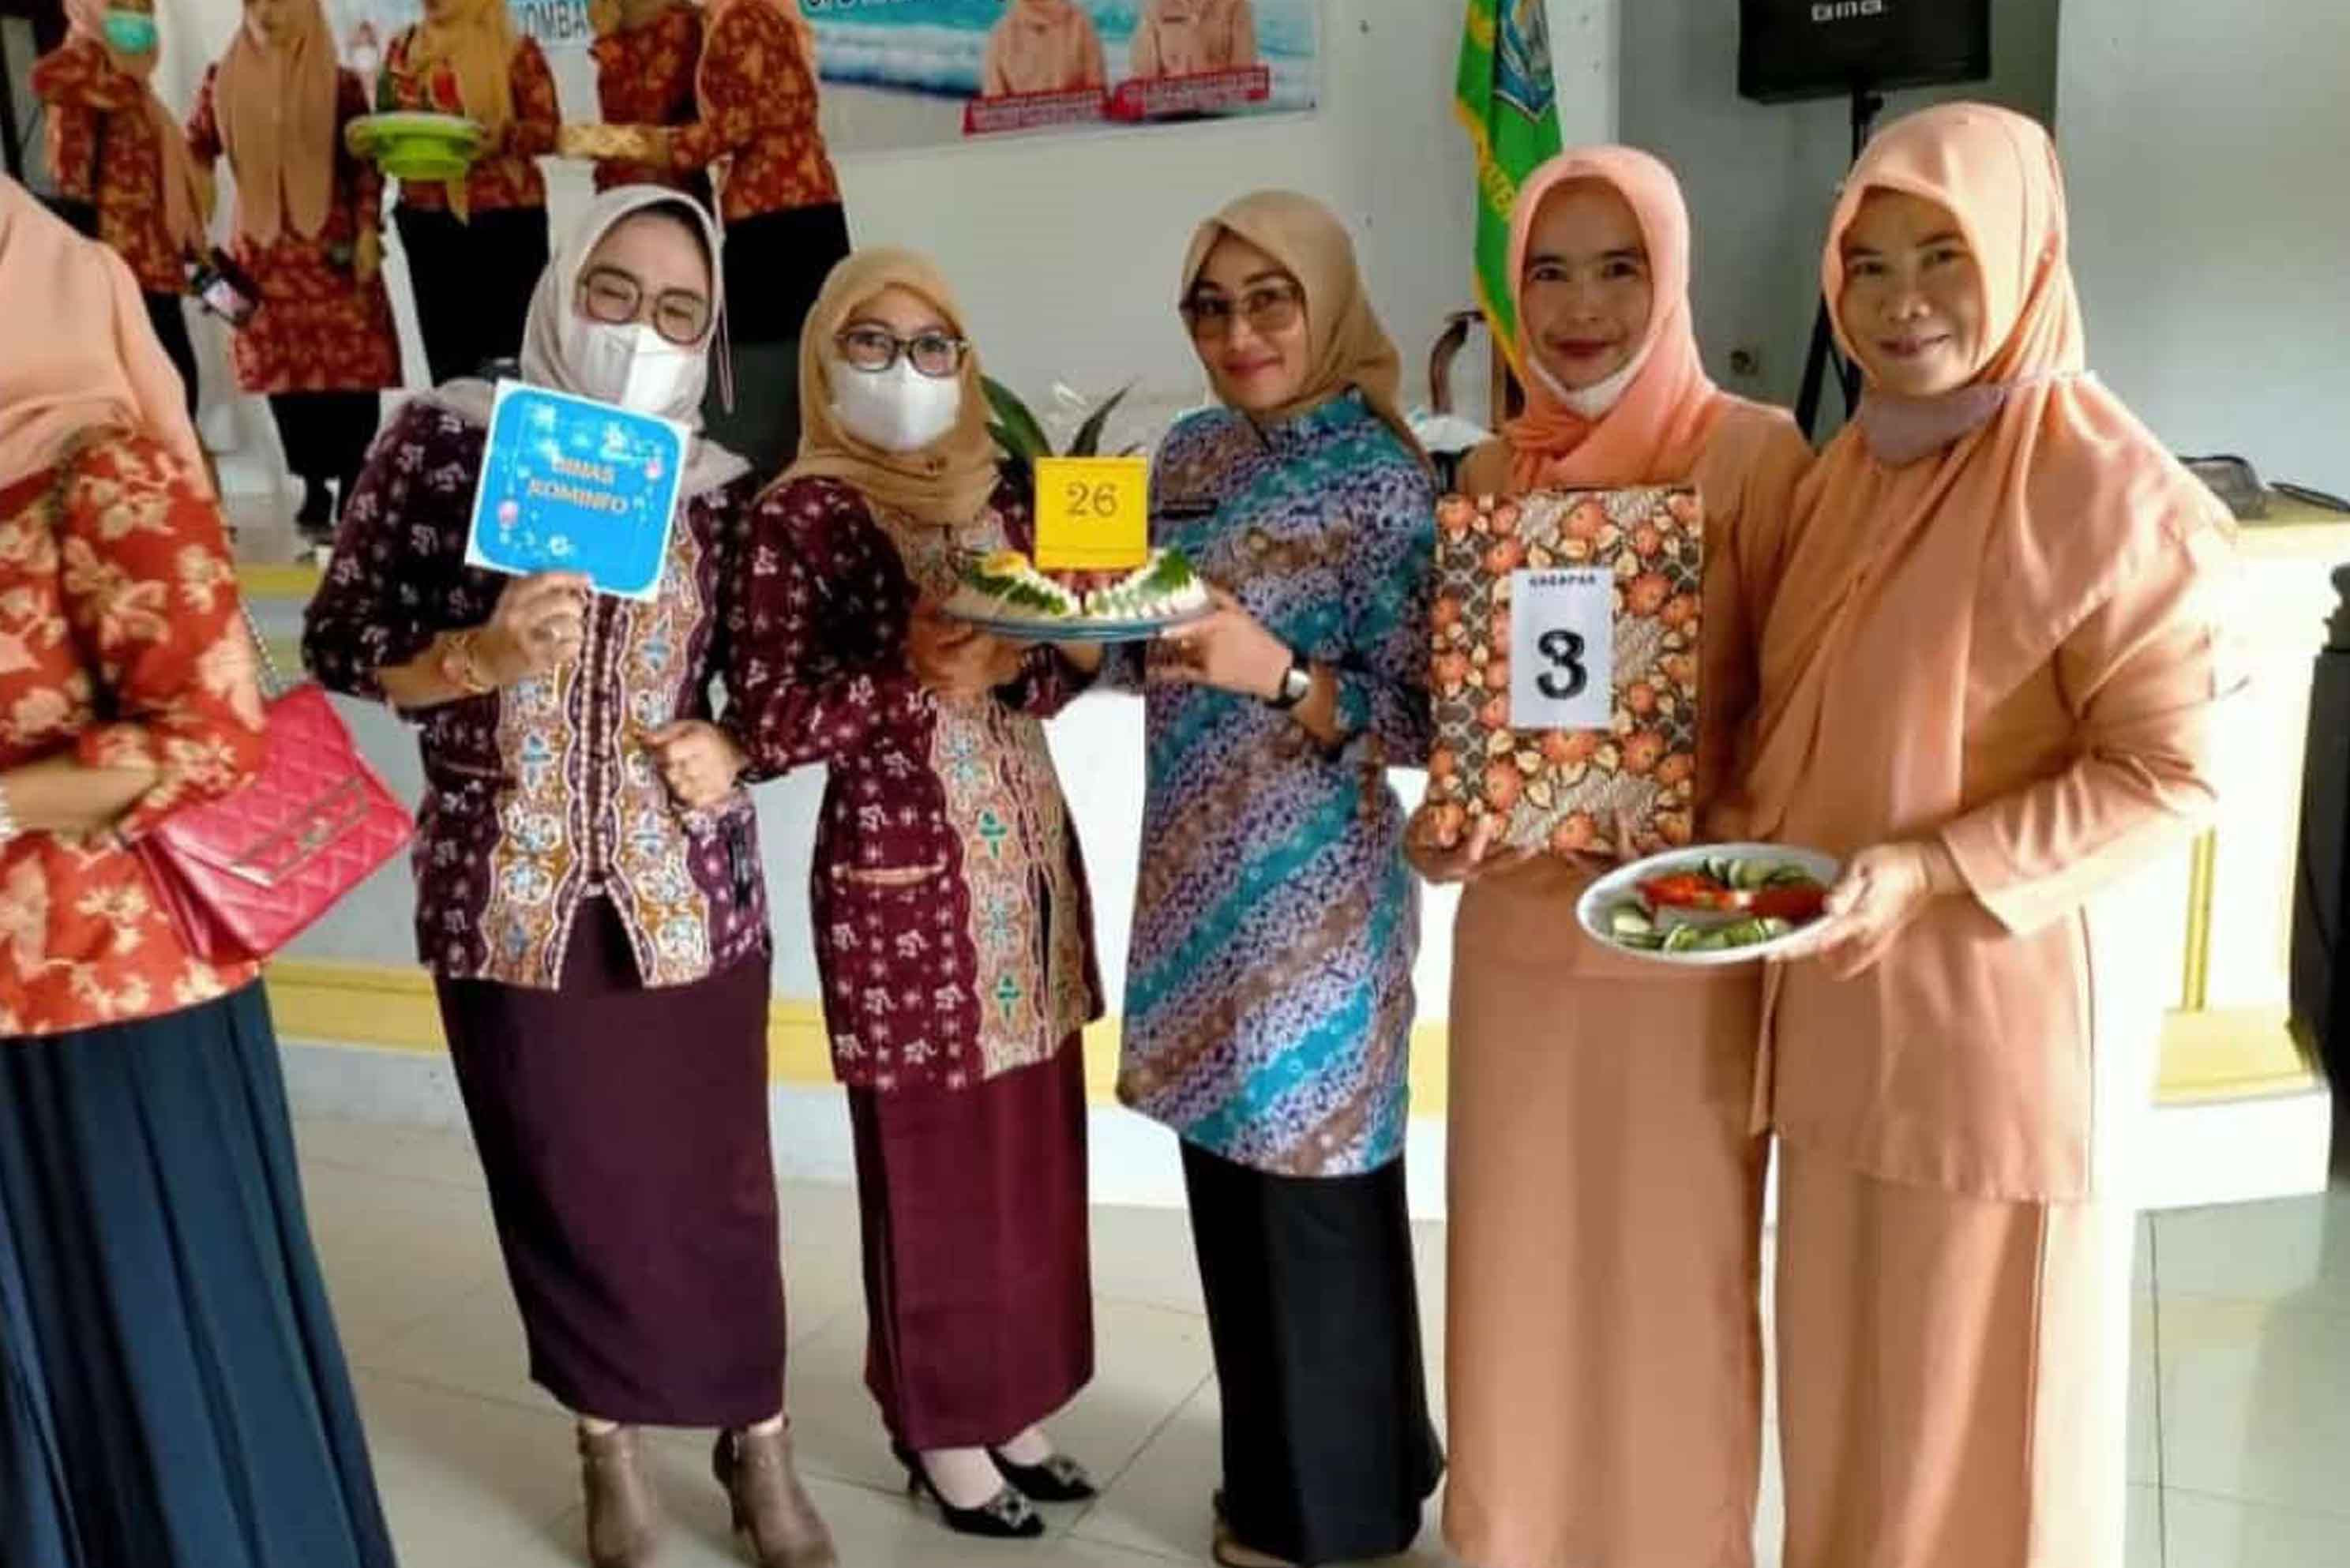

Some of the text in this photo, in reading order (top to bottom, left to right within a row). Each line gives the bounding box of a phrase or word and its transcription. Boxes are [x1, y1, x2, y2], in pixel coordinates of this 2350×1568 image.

[521, 0, 587, 38] OMBA
[529, 478, 628, 512] KOMINFO
[1065, 481, 1118, 517] 26
[1537, 629, 1588, 700] 3
